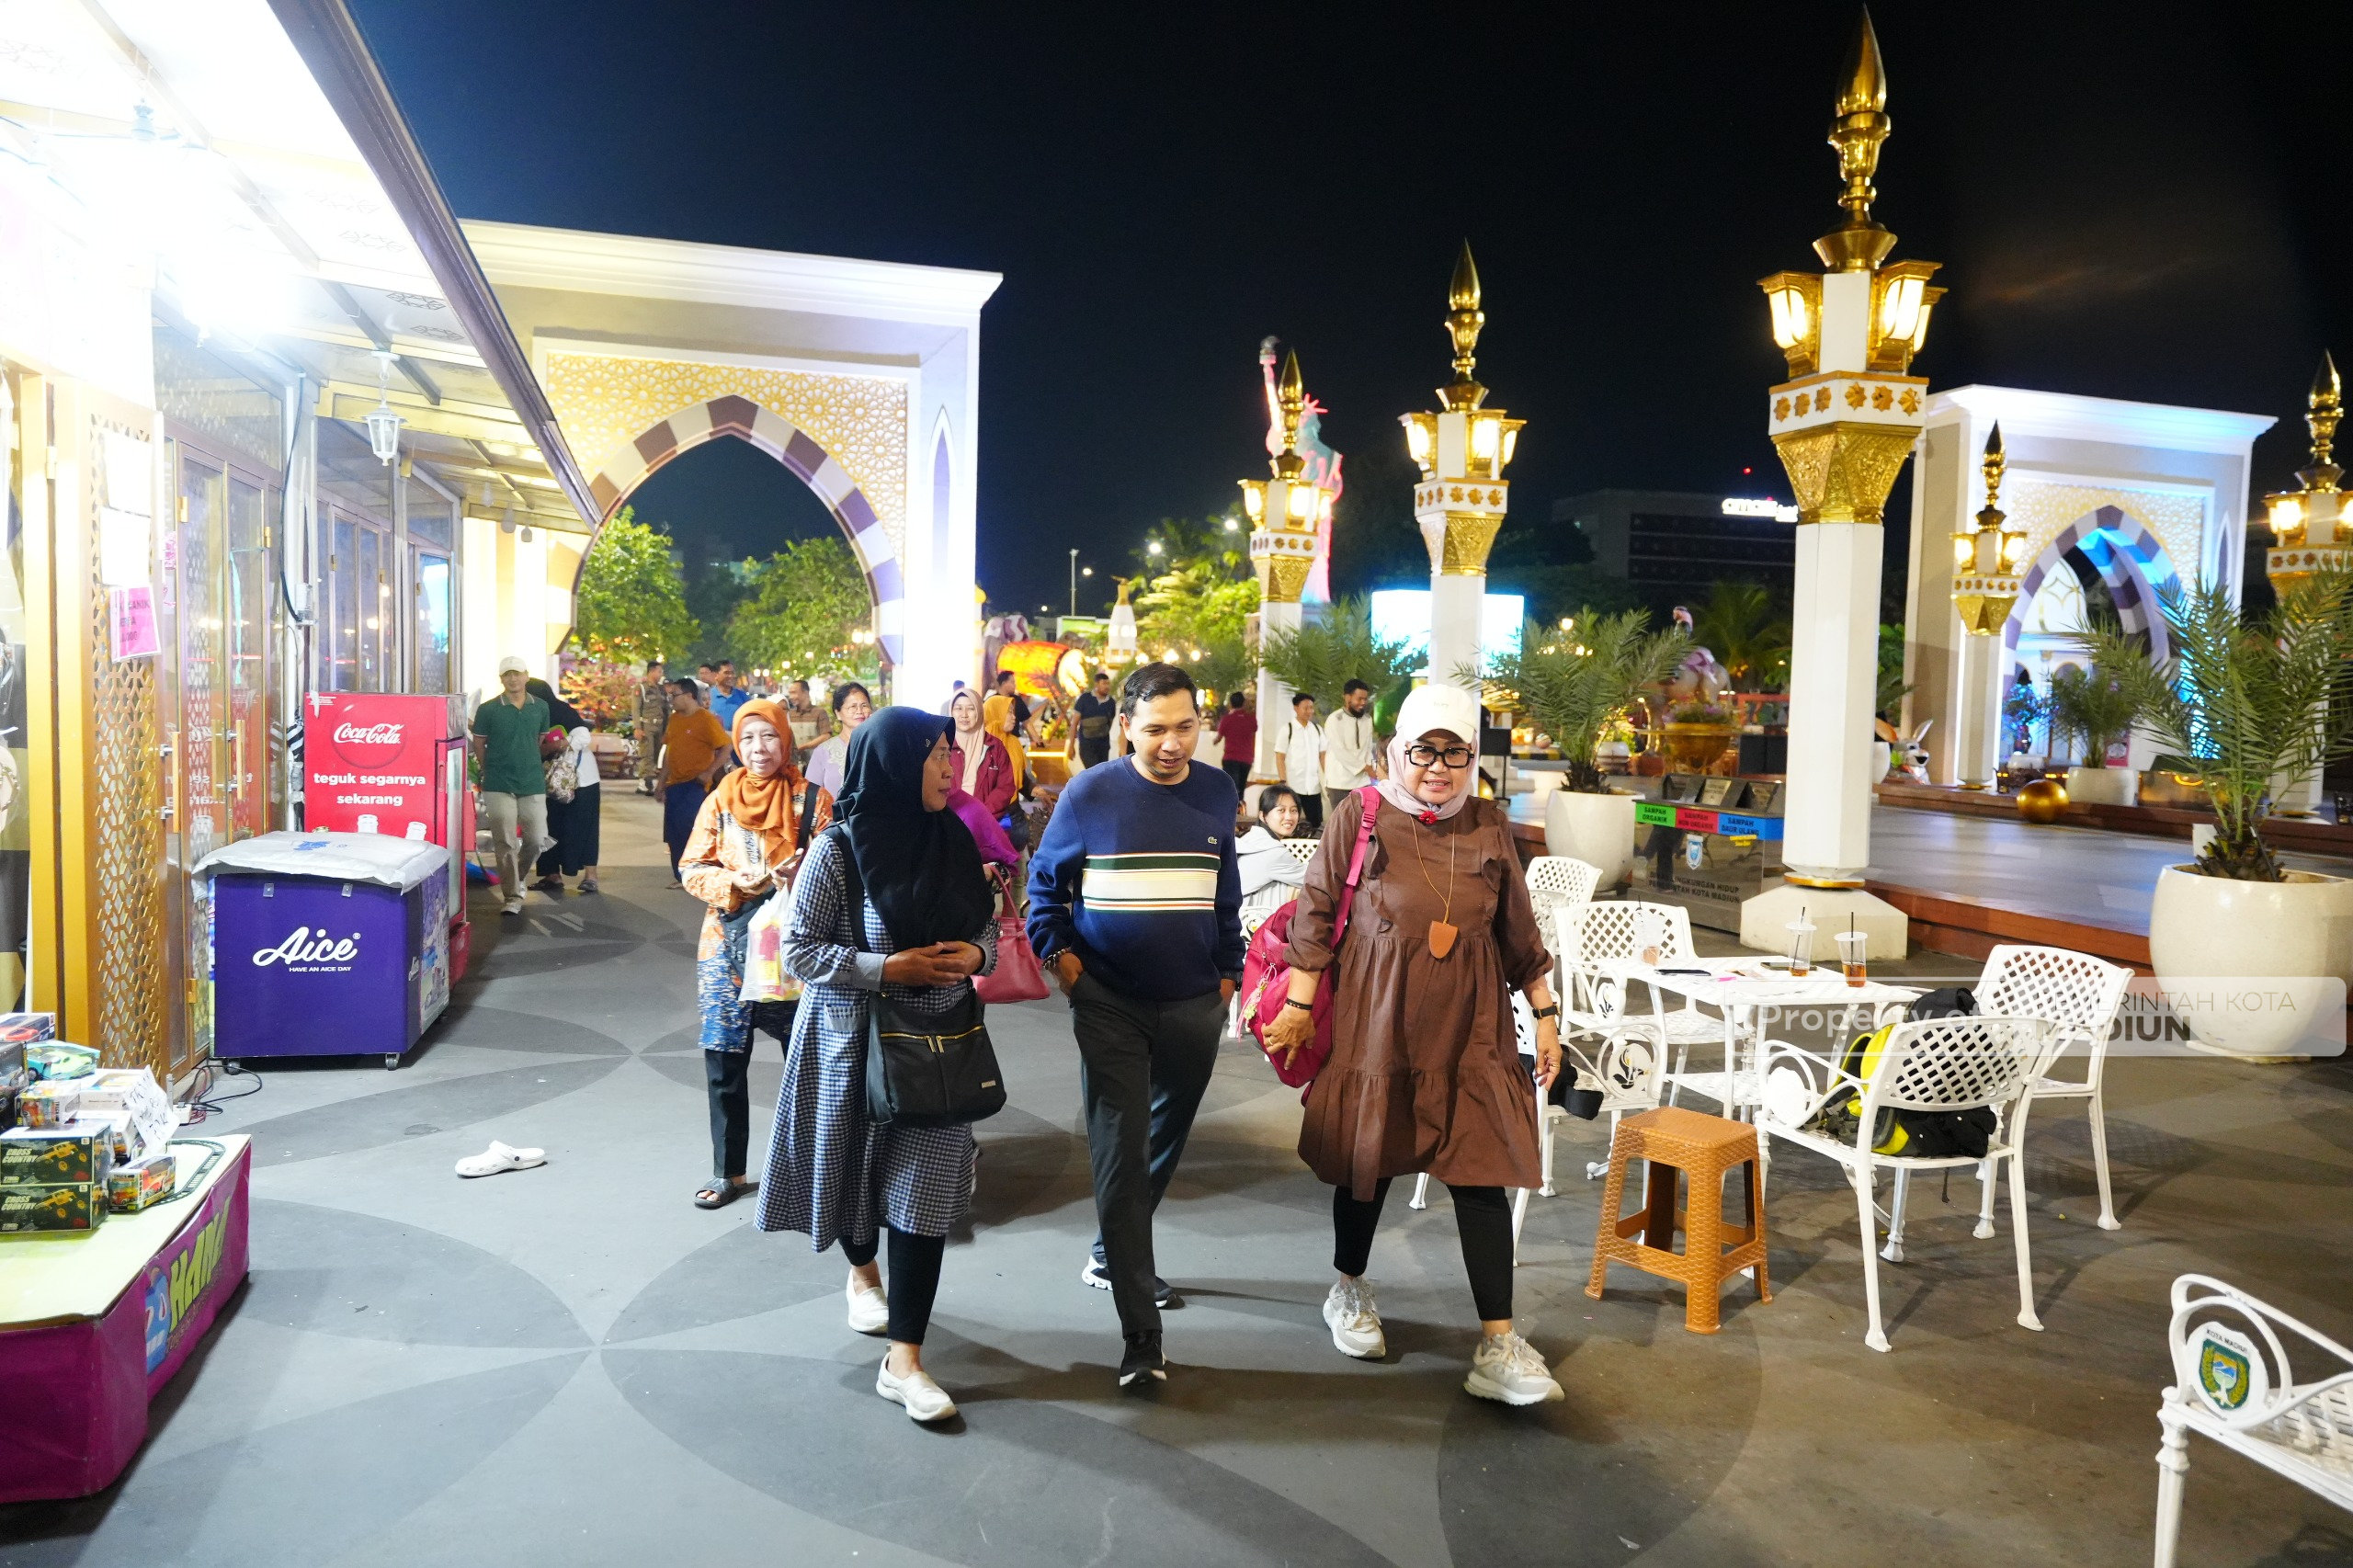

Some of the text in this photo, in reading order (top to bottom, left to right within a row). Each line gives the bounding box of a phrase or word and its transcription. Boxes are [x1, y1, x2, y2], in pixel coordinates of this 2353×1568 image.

[334, 722, 404, 744] Coca-Cola
[313, 773, 426, 786] teguk segarnya
[336, 793, 404, 806] sekarang
[1728, 817, 1754, 825] SAMPAH
[1673, 876, 1715, 889] INGKUNGAN
[1717, 884, 1739, 893] HIDUP
[253, 926, 358, 966] Aice
[2, 1155, 39, 1164] COUNTRY
[1, 1202, 37, 1210] COUNTRY
[2206, 1328, 2223, 1342] KOTA
